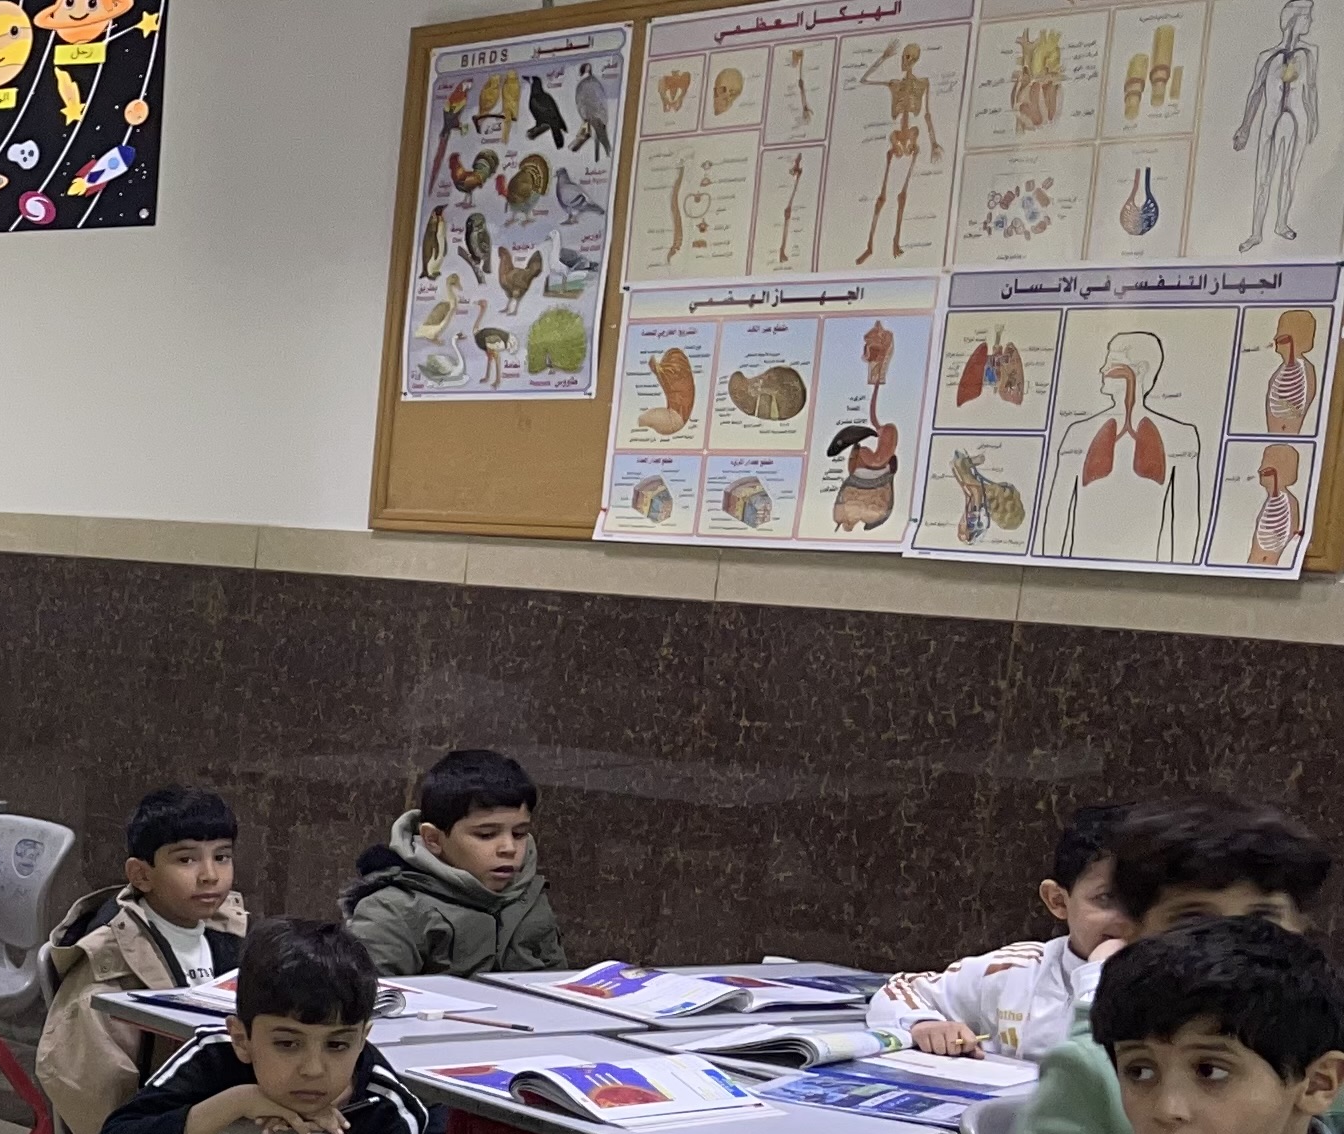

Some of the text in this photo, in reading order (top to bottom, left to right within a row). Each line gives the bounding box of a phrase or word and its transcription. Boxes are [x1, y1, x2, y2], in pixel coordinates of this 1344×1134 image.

[714, 1, 902, 45] الهيكل العظمي
[461, 48, 509, 68] BIRDS
[532, 36, 595, 60] الطيور
[1079, 279, 1112, 299] في
[1114, 275, 1208, 300] التنفسي
[1211, 272, 1283, 297] الجهاز
[689, 287, 864, 314] الجهاز الهضمي
